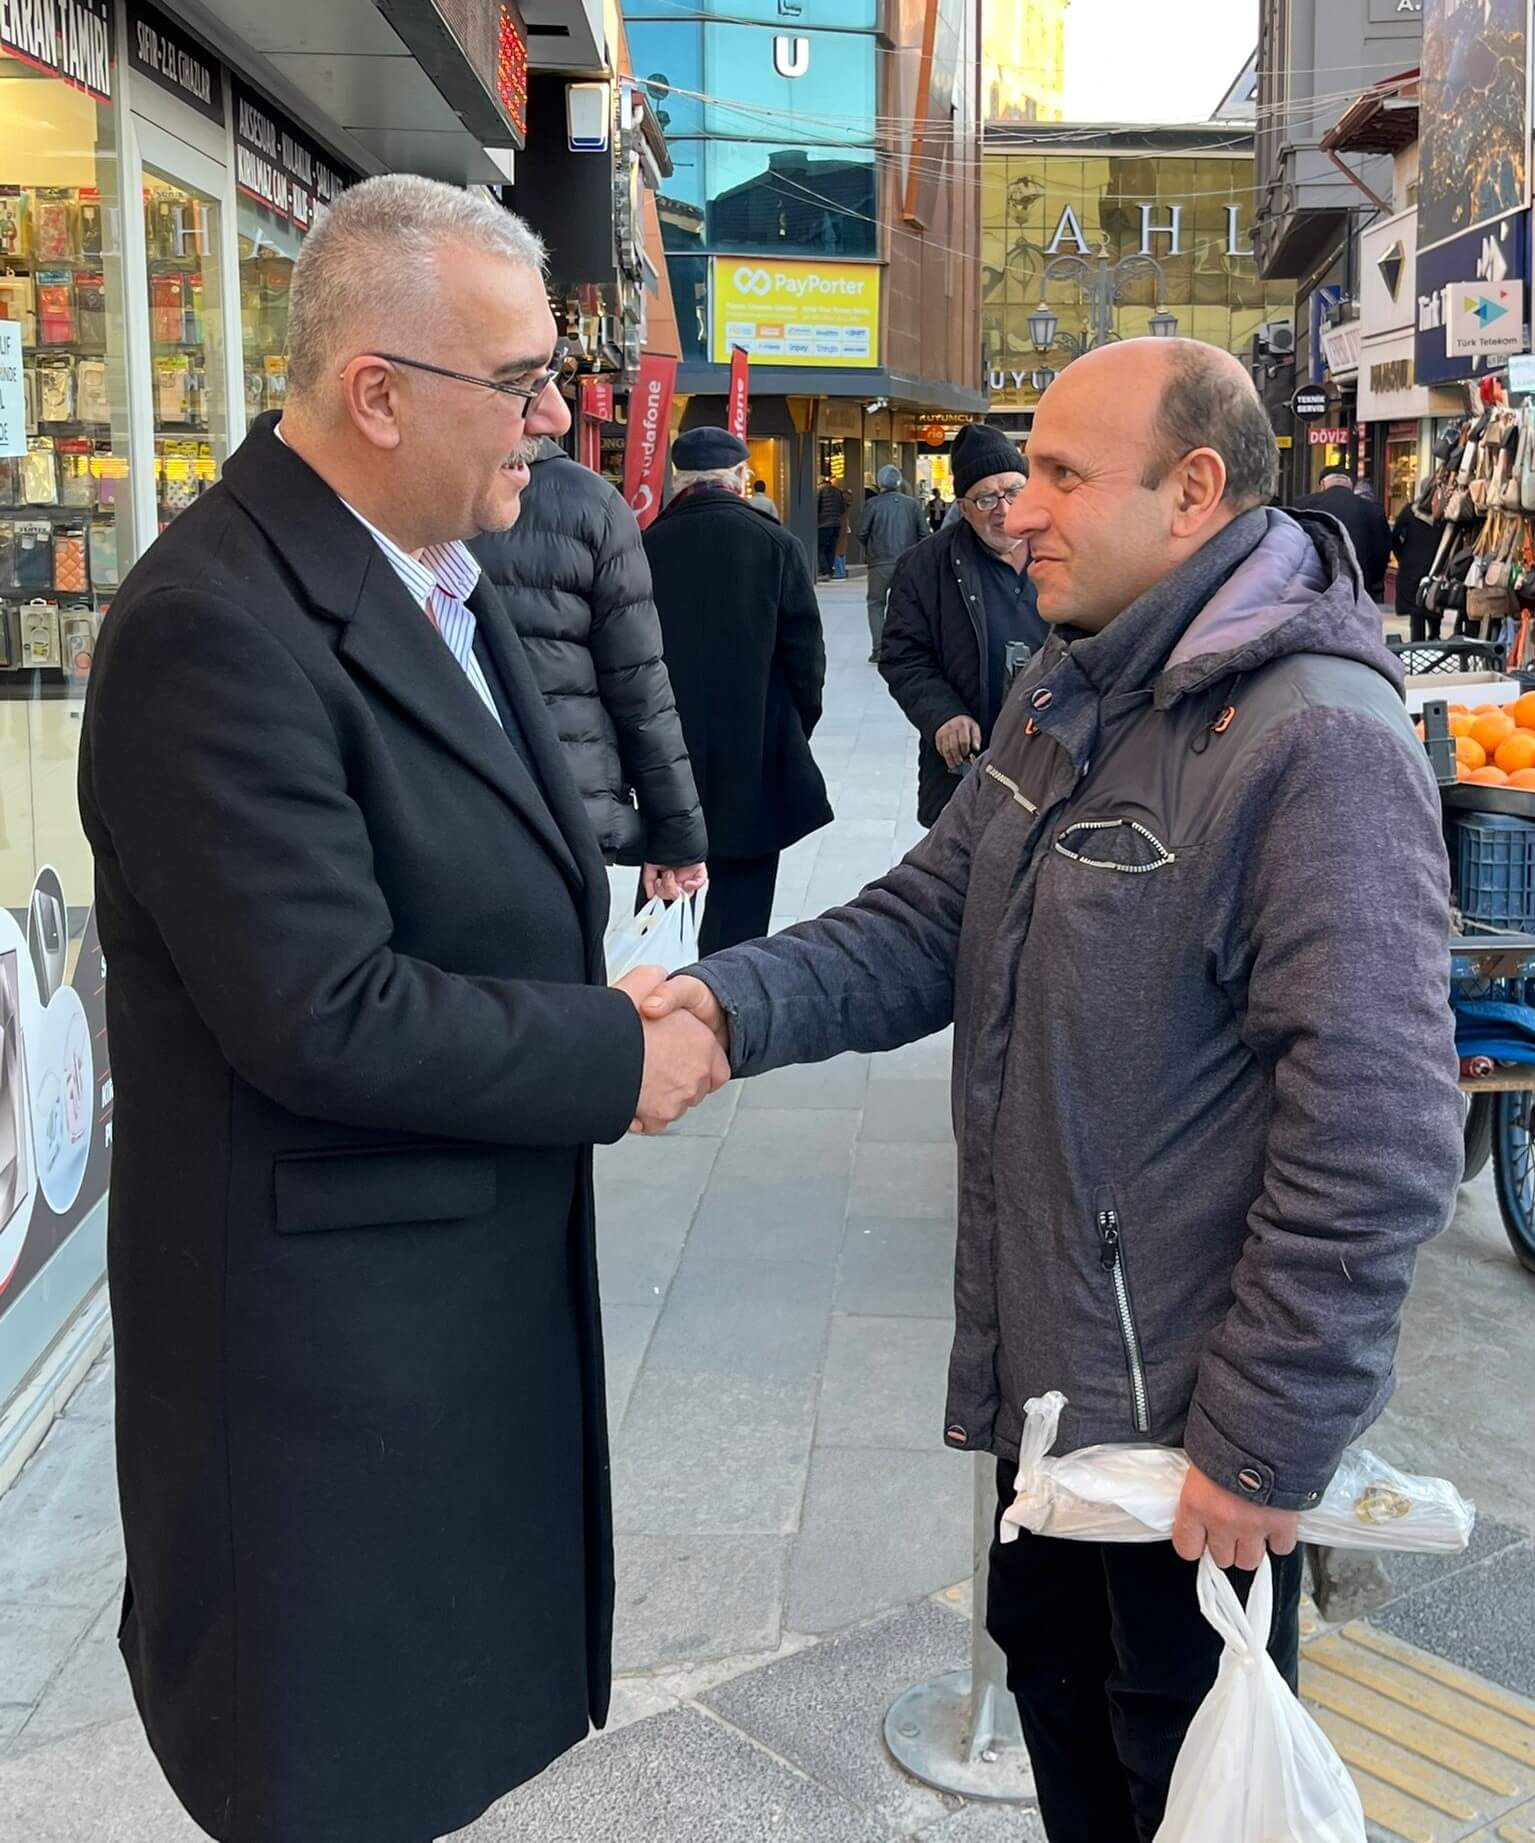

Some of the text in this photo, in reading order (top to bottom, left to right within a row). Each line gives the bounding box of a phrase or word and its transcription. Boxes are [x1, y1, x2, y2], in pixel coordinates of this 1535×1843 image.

[775, 272, 865, 297] PayPorter
[1480, 337, 1518, 346] Telekom
[1310, 429, 1348, 444] DÖVİZ
